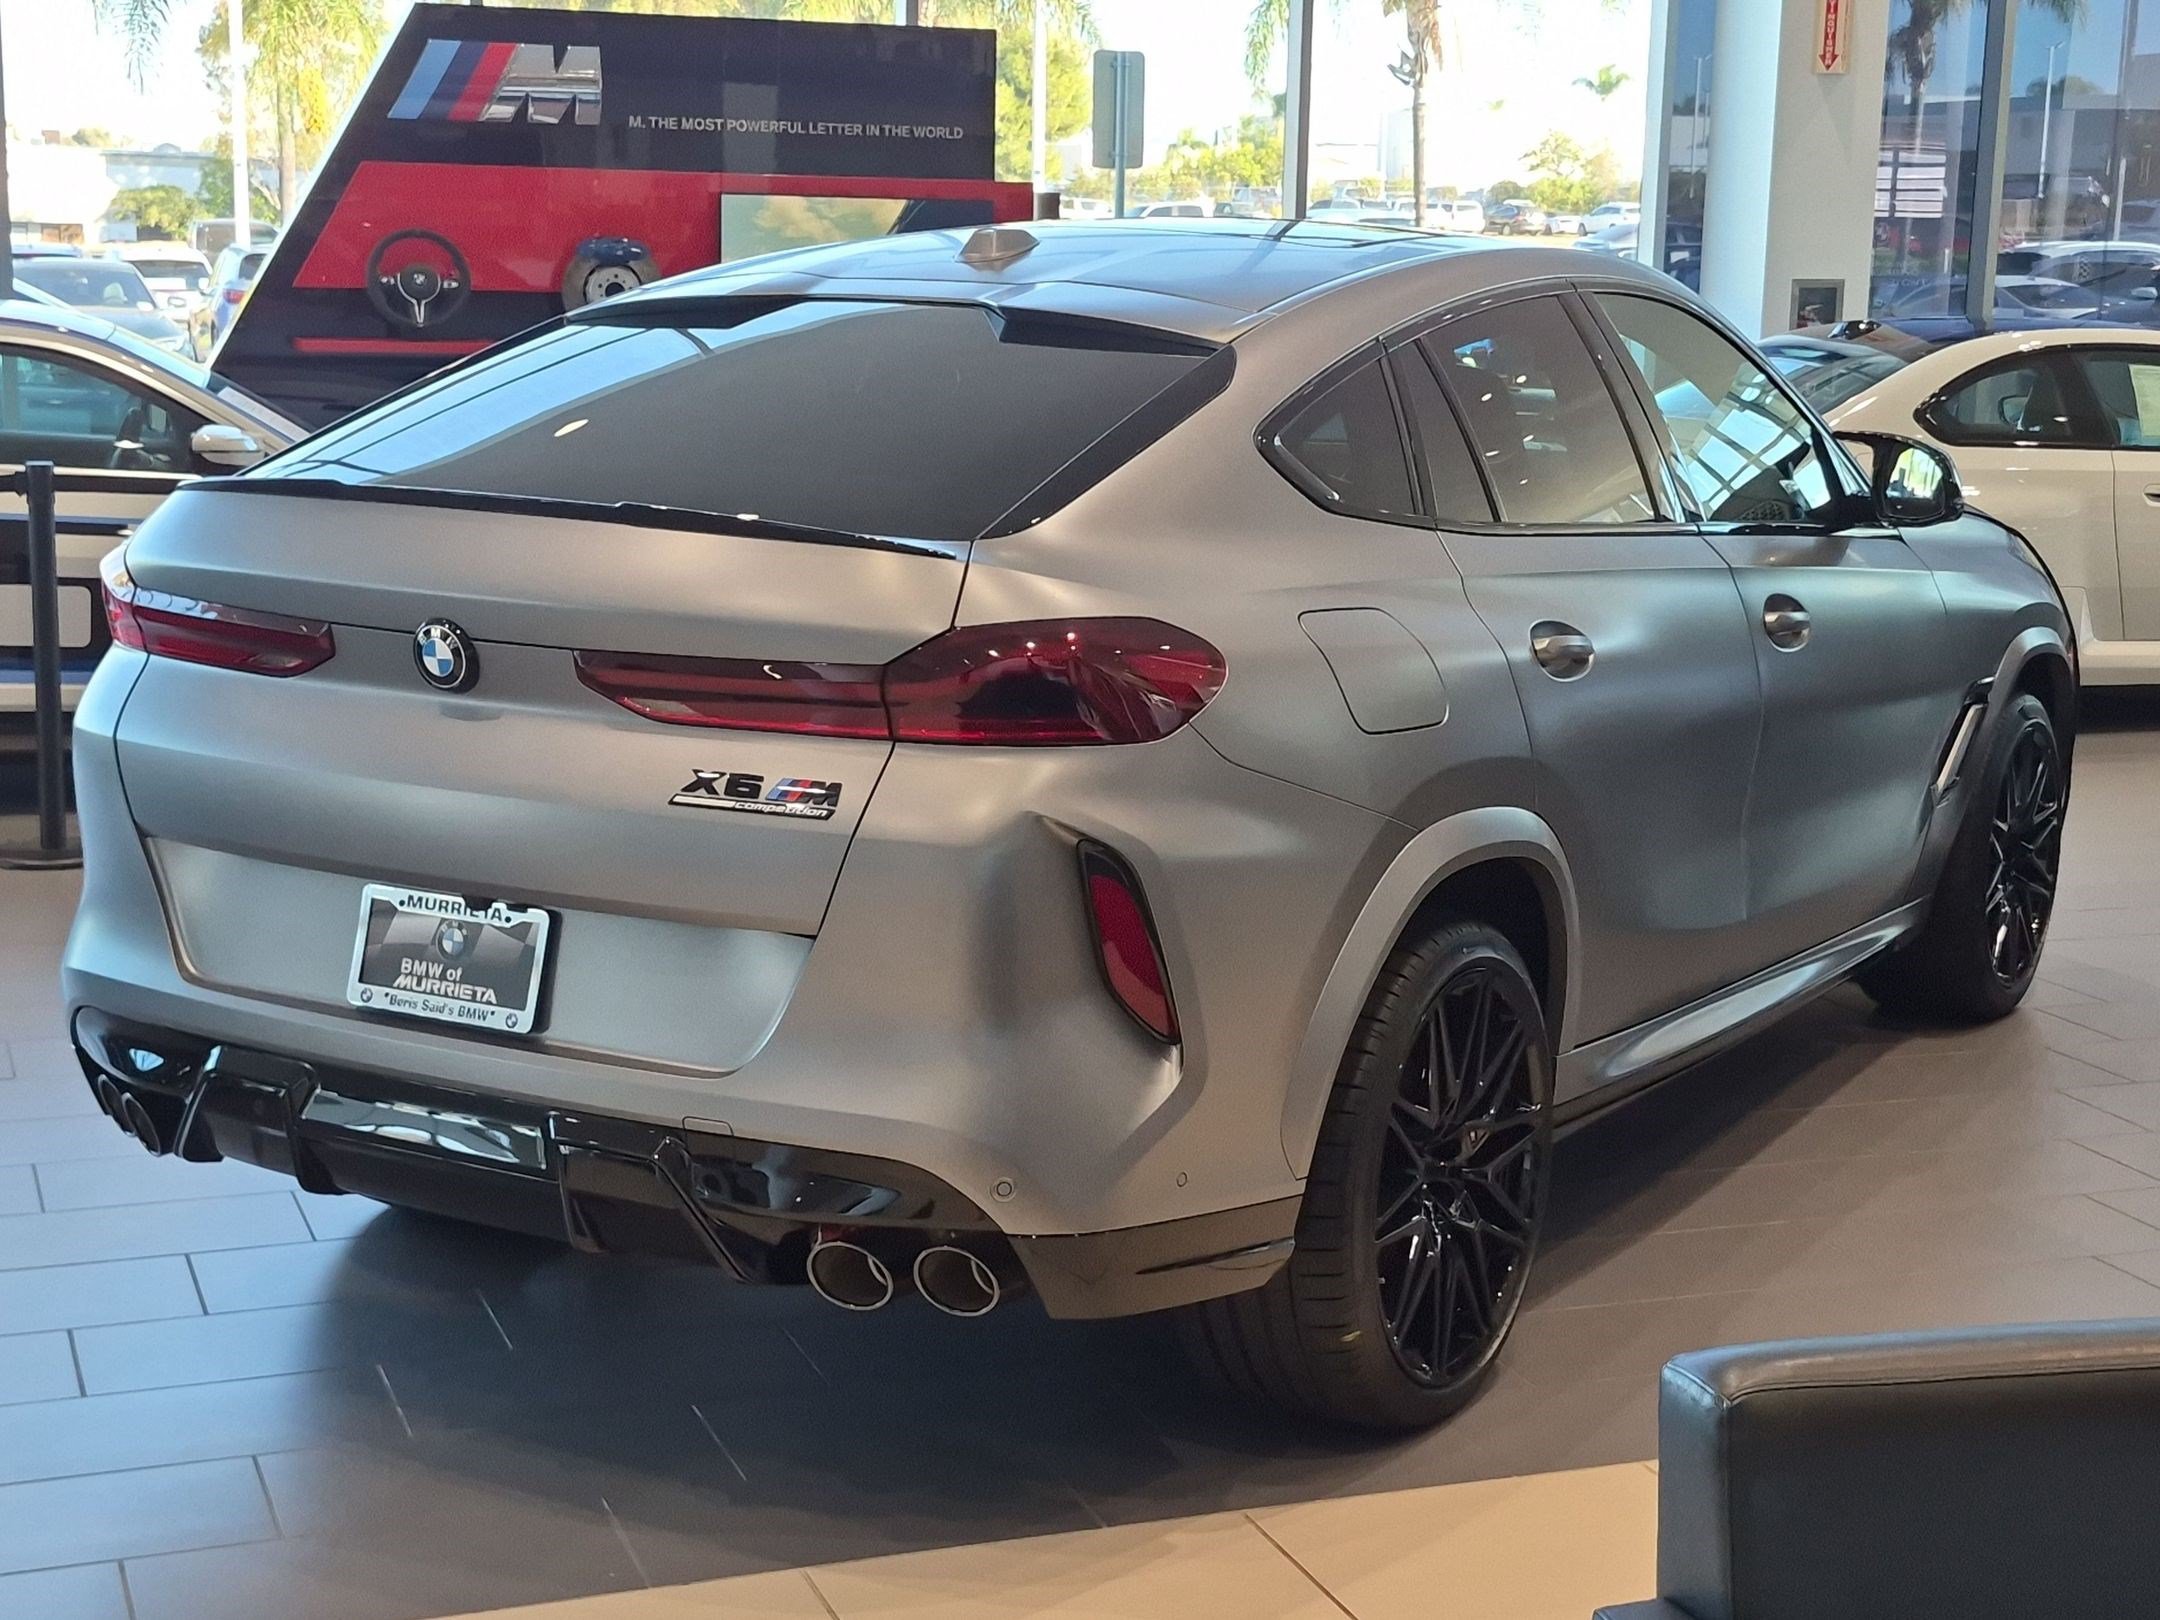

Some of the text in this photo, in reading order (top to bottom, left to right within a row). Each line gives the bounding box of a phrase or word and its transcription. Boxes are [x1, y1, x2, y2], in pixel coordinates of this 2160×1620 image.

[629, 115, 963, 139] M. THE MOST POWERFUL LETTER IN THE WORLD
[417, 627, 459, 650] BMW
[681, 769, 764, 799] X6
[401, 957, 463, 981] BMW of
[393, 973, 497, 1005] MURRIETA
